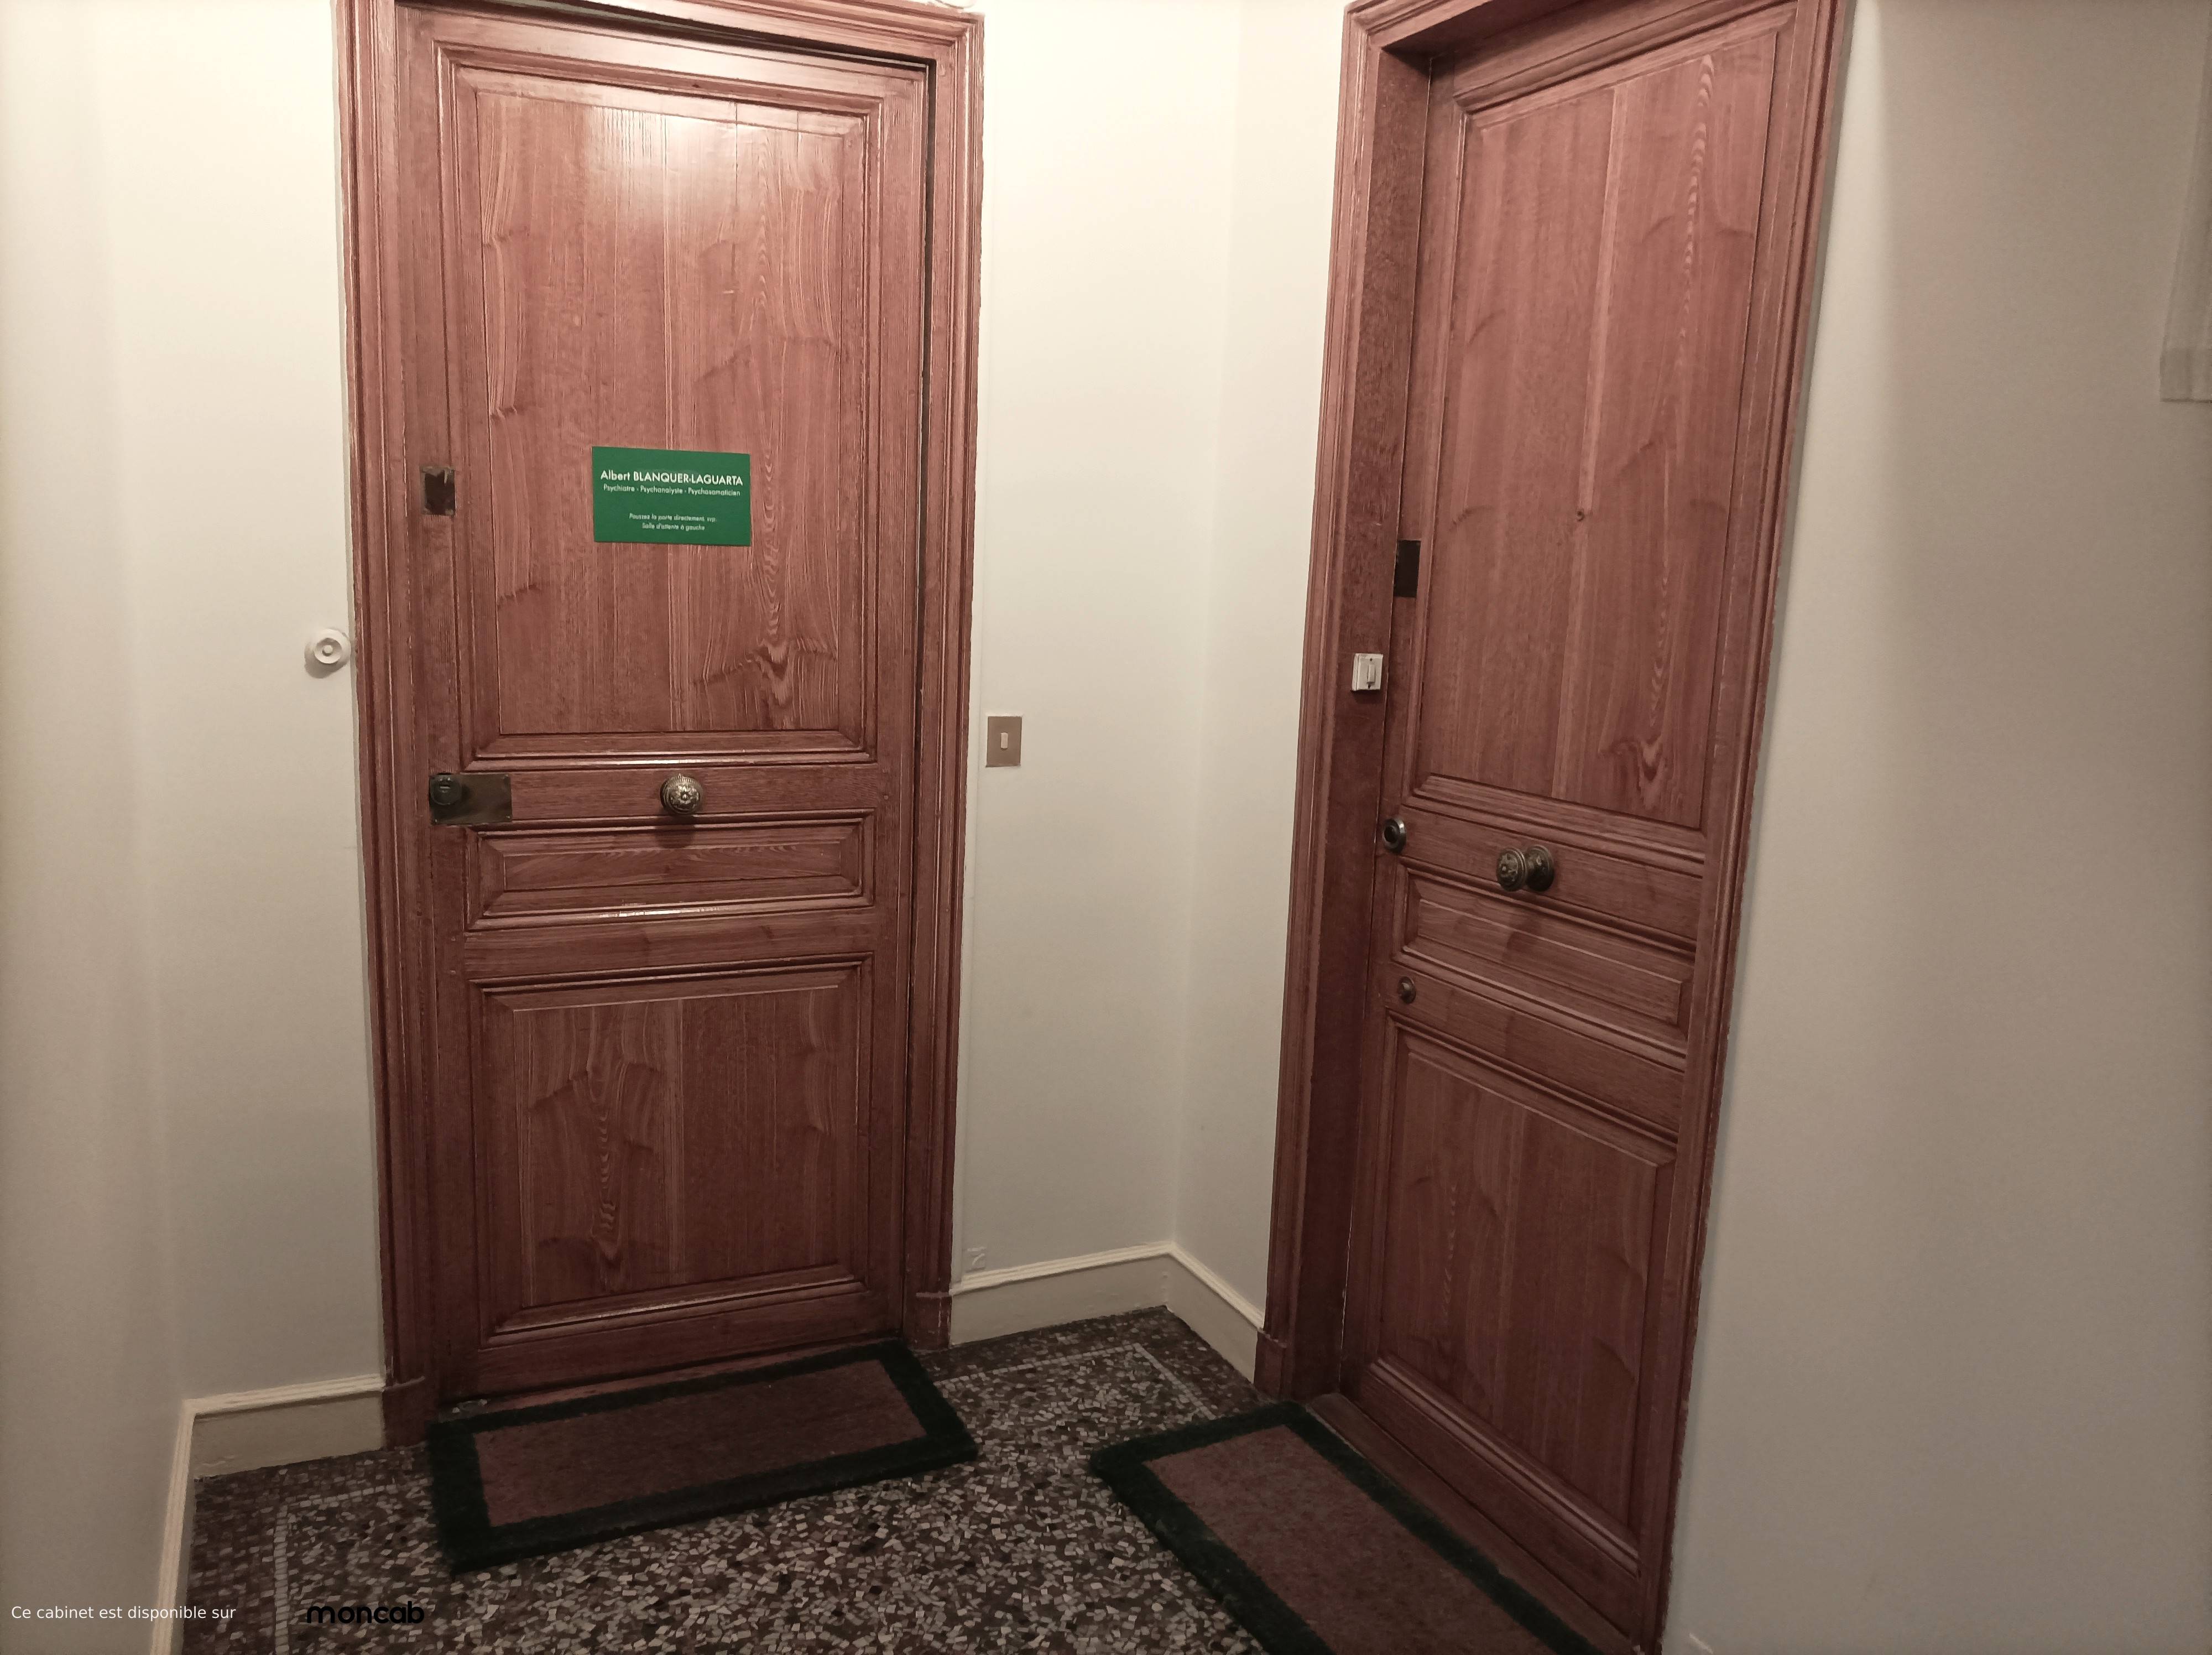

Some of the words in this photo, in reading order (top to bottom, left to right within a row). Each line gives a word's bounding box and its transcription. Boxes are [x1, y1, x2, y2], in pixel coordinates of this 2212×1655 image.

[601, 470, 630, 481] Albert
[633, 471, 743, 486] BLANQUER-LAGUARTA
[603, 483, 635, 492] Psychiatre
[640, 485, 683, 495] Psychanalyste
[688, 487, 740, 496] Psychosomaticien
